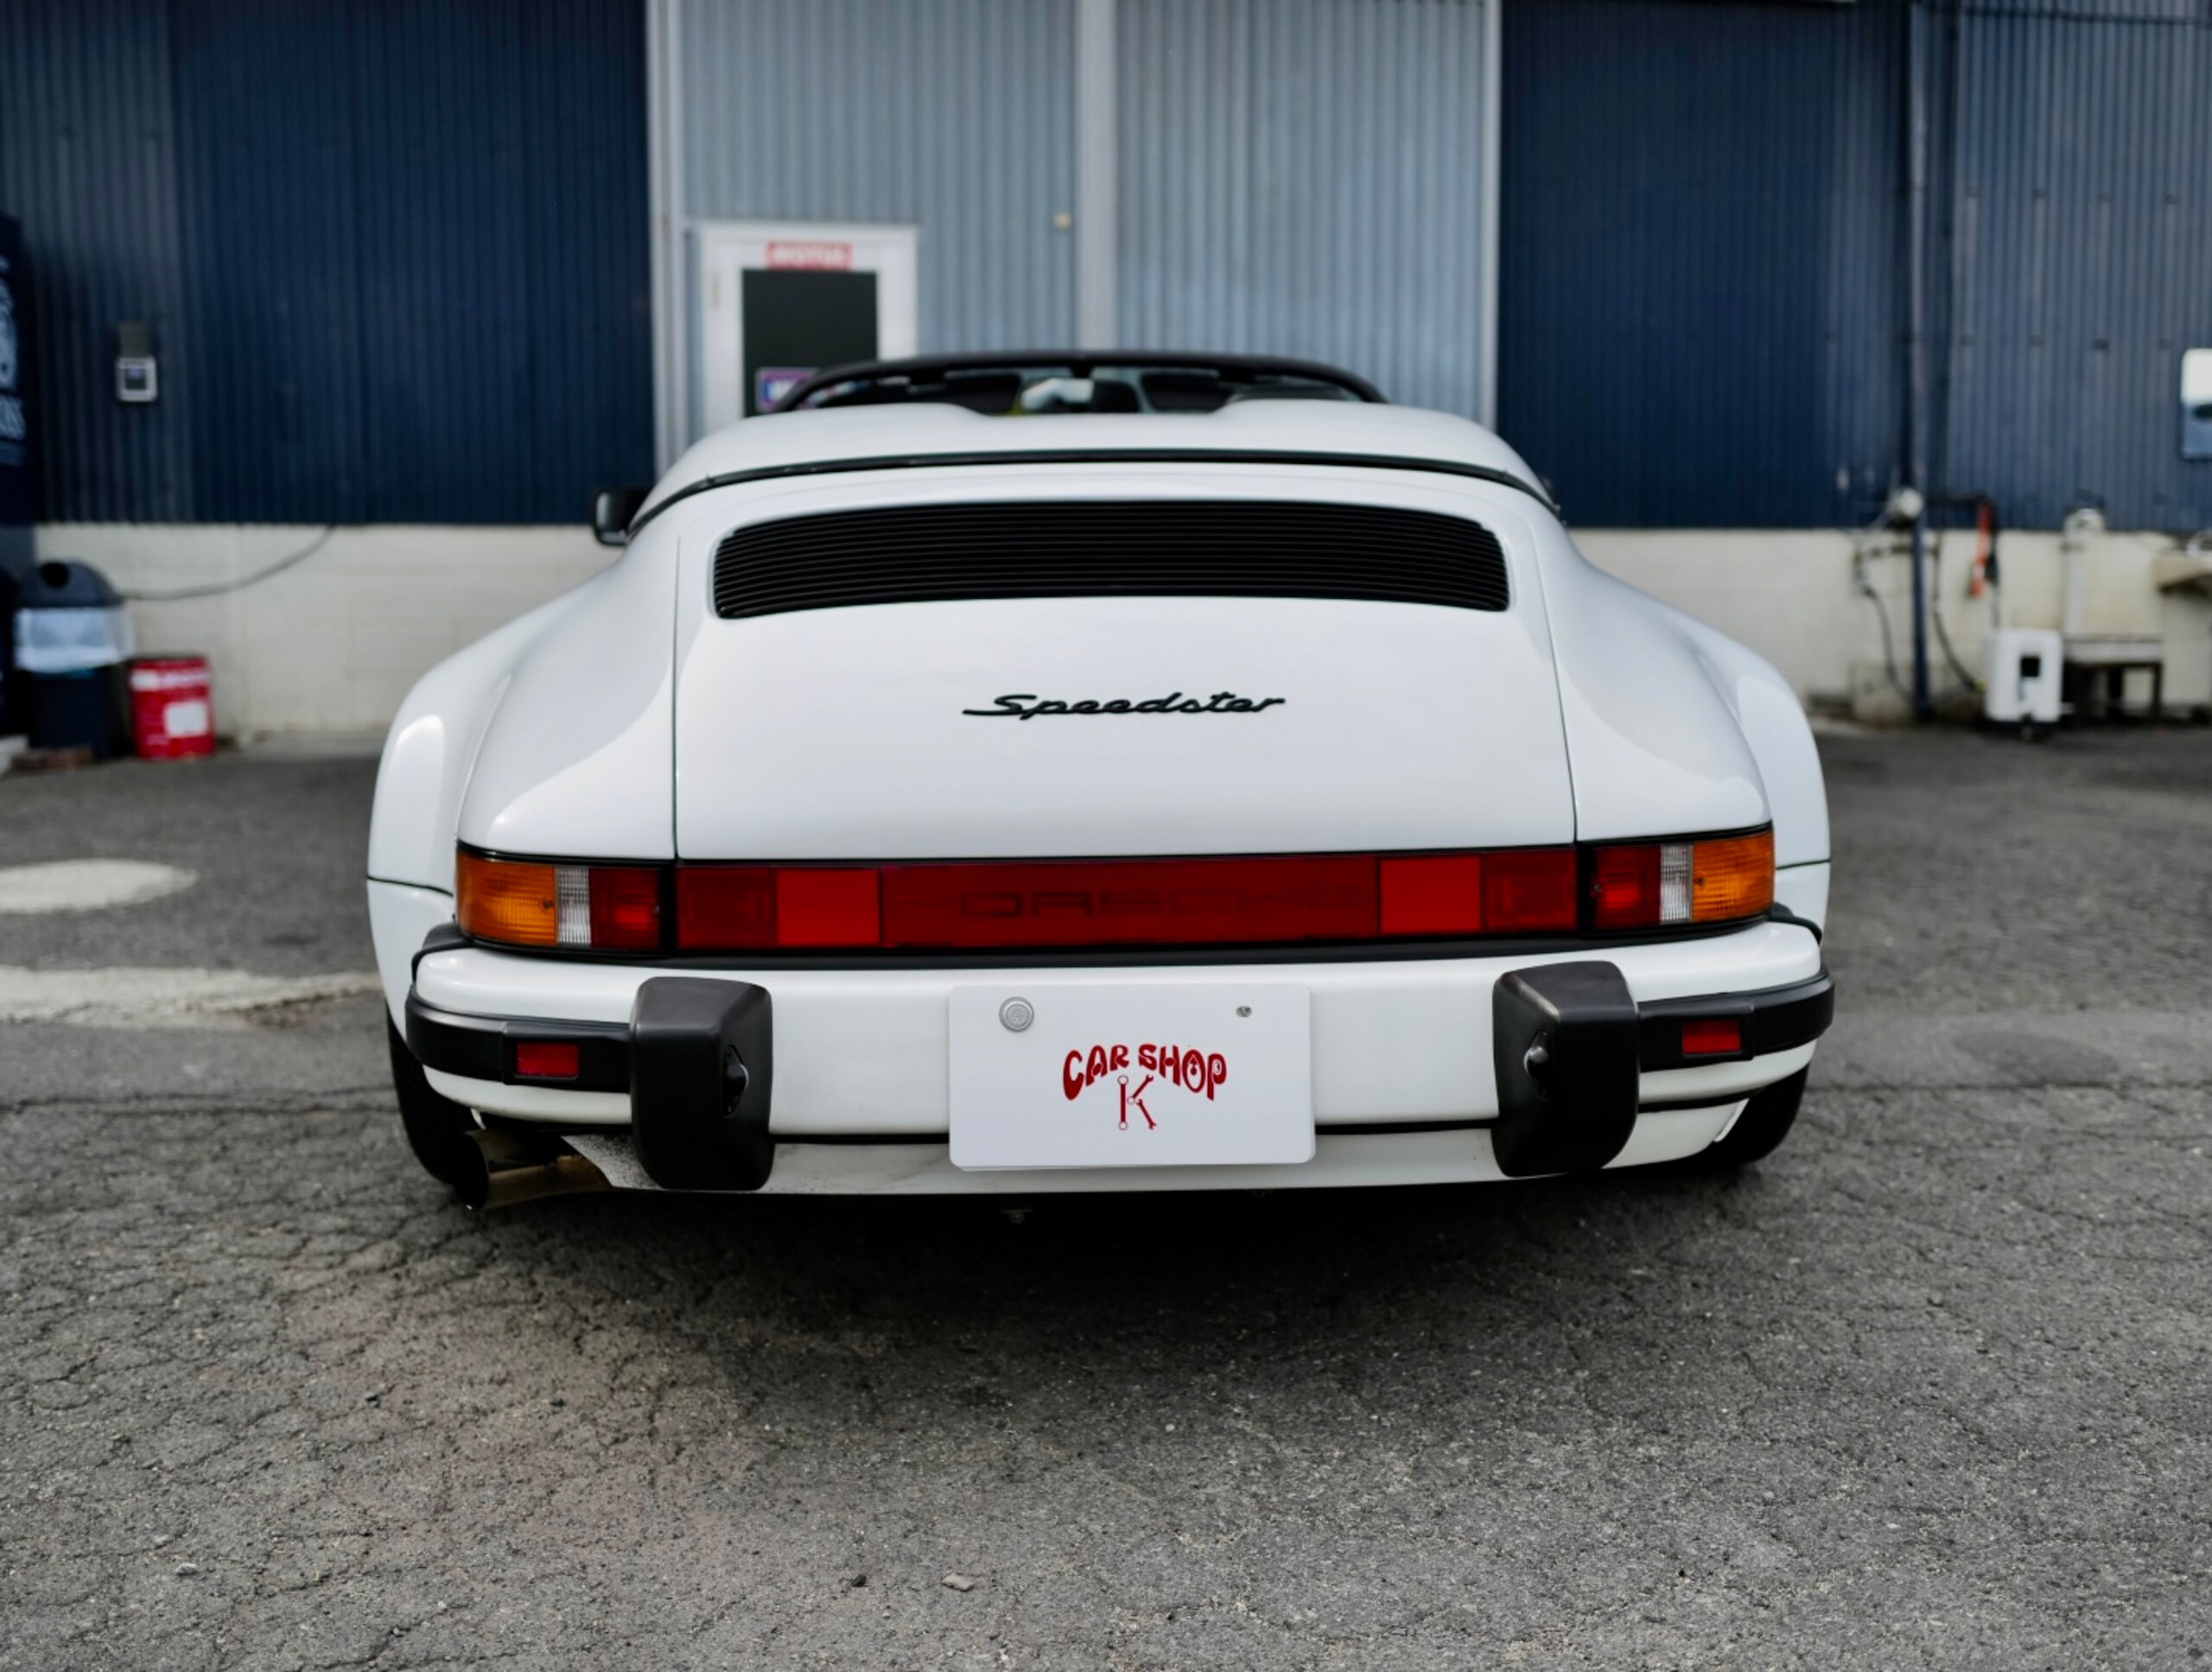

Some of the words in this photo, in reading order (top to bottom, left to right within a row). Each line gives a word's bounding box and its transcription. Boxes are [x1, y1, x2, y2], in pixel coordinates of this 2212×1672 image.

[962, 690, 1286, 721] Speedster
[1063, 1043, 1130, 1101] CAR
[1137, 1042, 1228, 1101] SHOP
